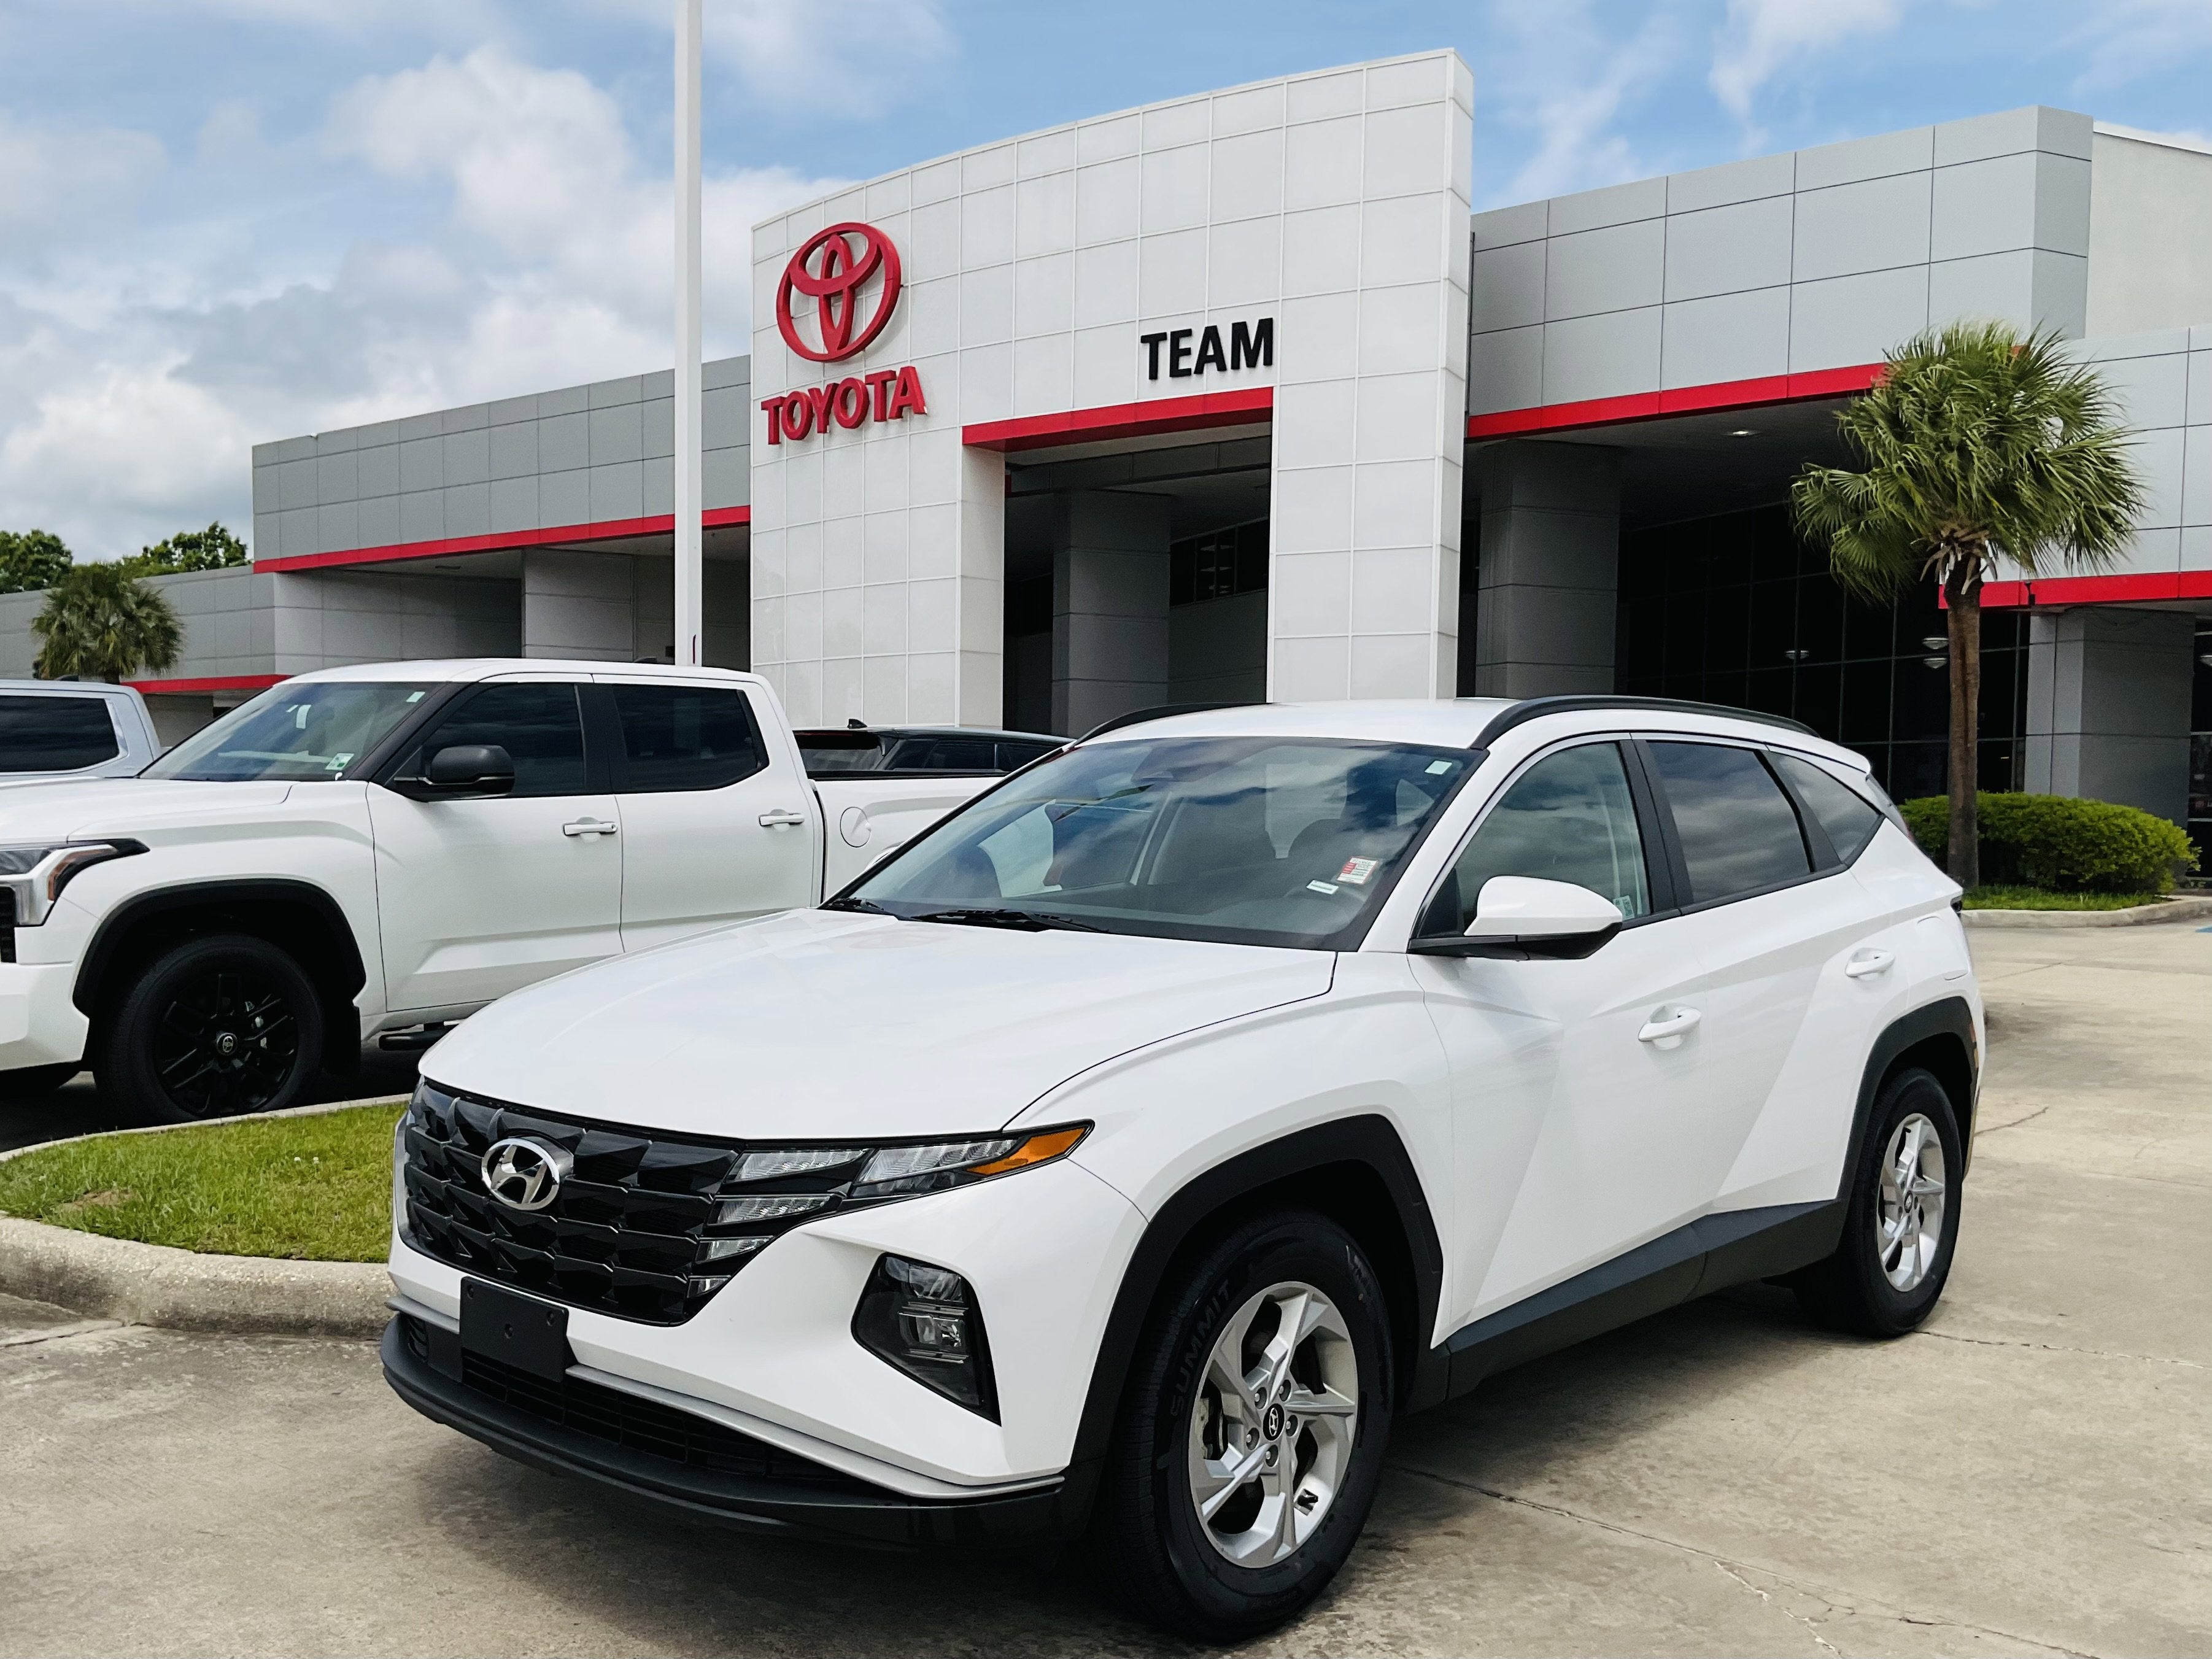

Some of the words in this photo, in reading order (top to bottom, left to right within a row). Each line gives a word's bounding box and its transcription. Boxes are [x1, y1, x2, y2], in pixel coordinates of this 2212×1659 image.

[1140, 317, 1274, 380] TEAM
[760, 366, 927, 445] TOYOTA
[1170, 1278, 1229, 1417] SUMMIT
